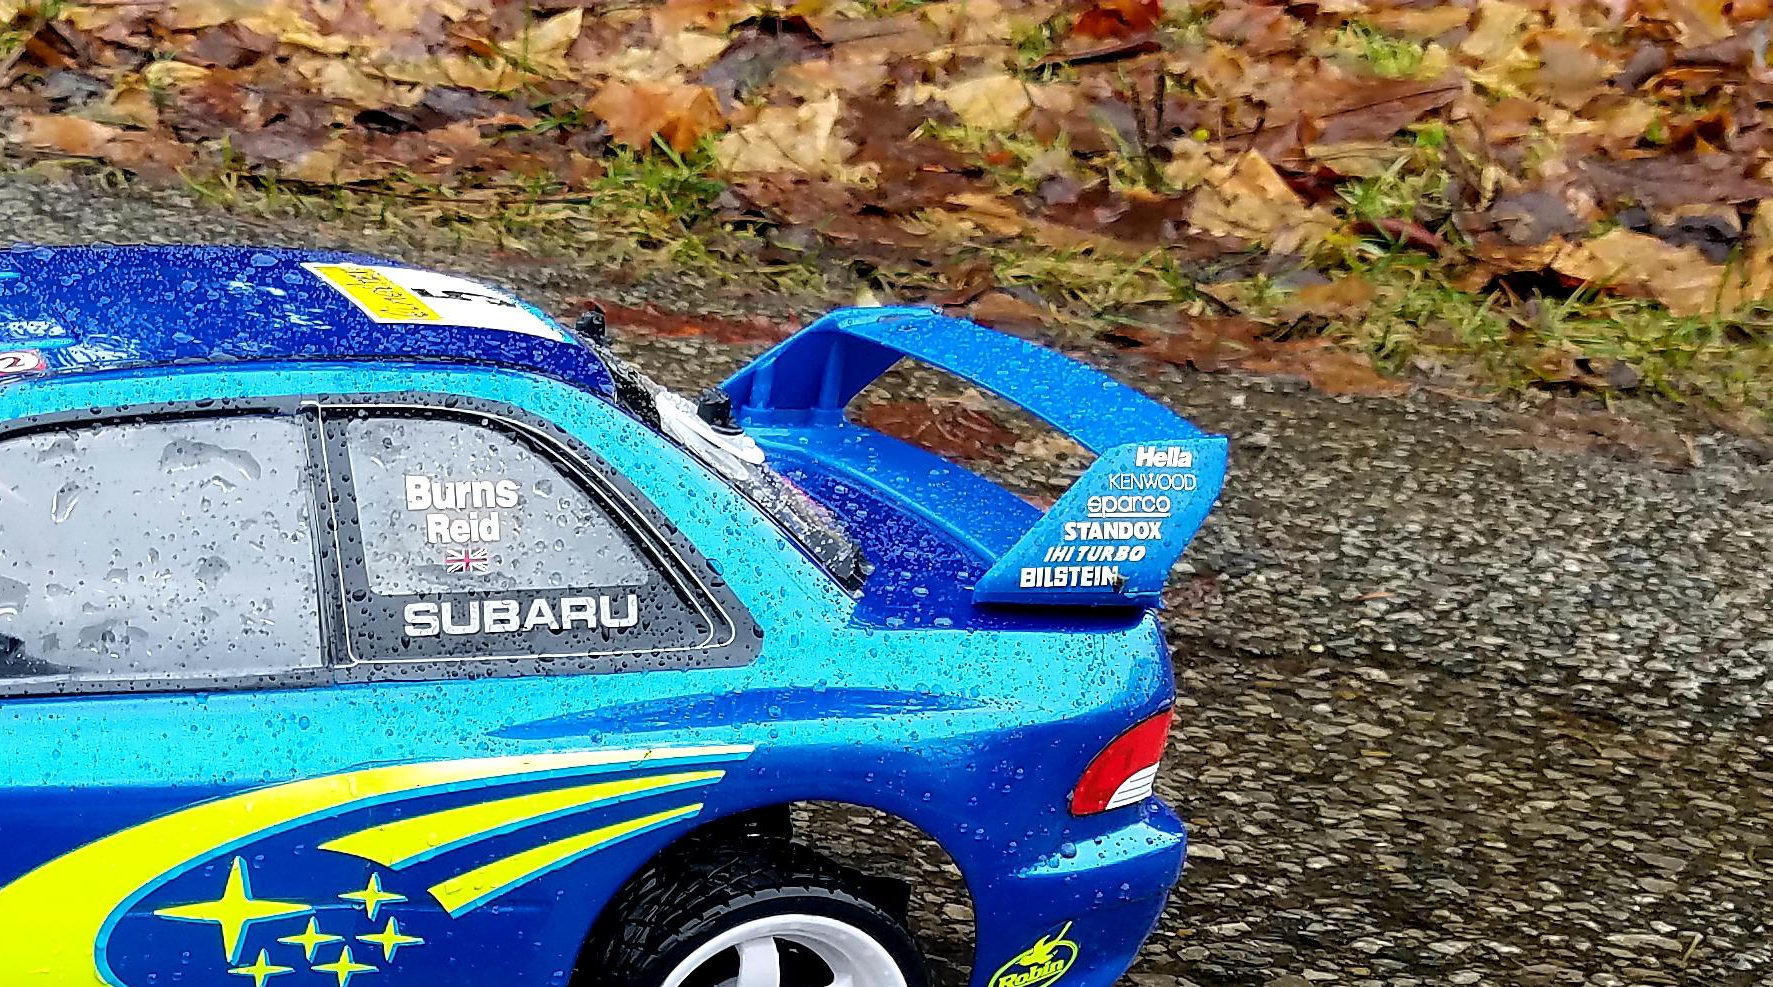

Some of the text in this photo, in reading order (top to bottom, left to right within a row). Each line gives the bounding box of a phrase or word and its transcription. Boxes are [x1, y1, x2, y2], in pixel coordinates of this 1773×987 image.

[1136, 446, 1193, 468] Hella
[405, 475, 521, 511] Burns
[1109, 473, 1197, 491] KENWOOD
[1087, 495, 1171, 519] sparco
[426, 512, 501, 543] Reid
[1063, 521, 1162, 540] STANDOX
[1043, 545, 1146, 562] IHI TURBO
[1019, 566, 1119, 588] BILSTEIN
[403, 594, 639, 637] SUBARU
